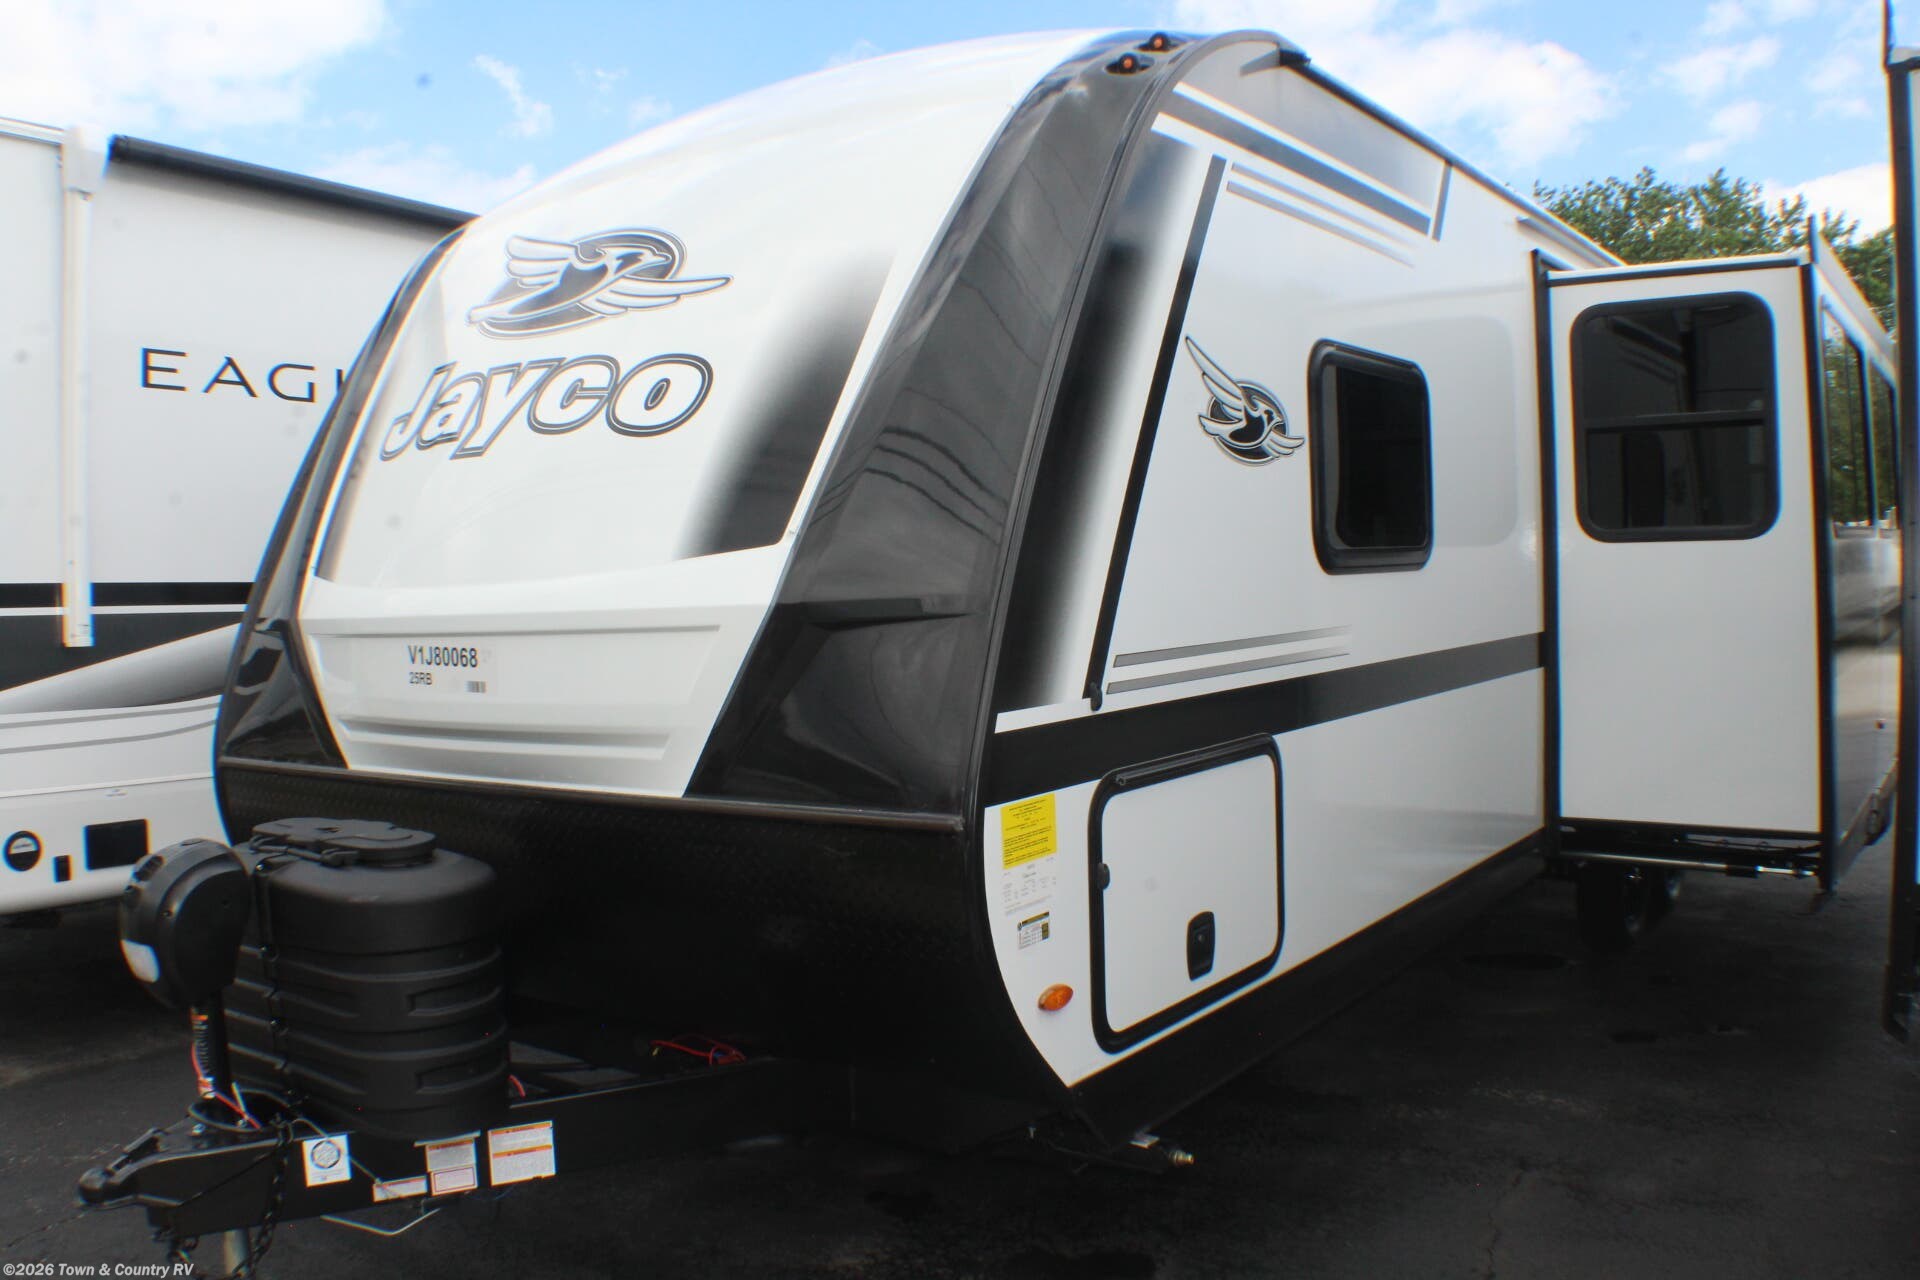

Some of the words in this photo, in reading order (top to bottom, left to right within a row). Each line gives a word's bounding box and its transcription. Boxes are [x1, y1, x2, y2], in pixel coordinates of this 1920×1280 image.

[379, 353, 714, 461] Jayco
[407, 645, 478, 668] V1J80068
[409, 671, 433, 685] 25RB
